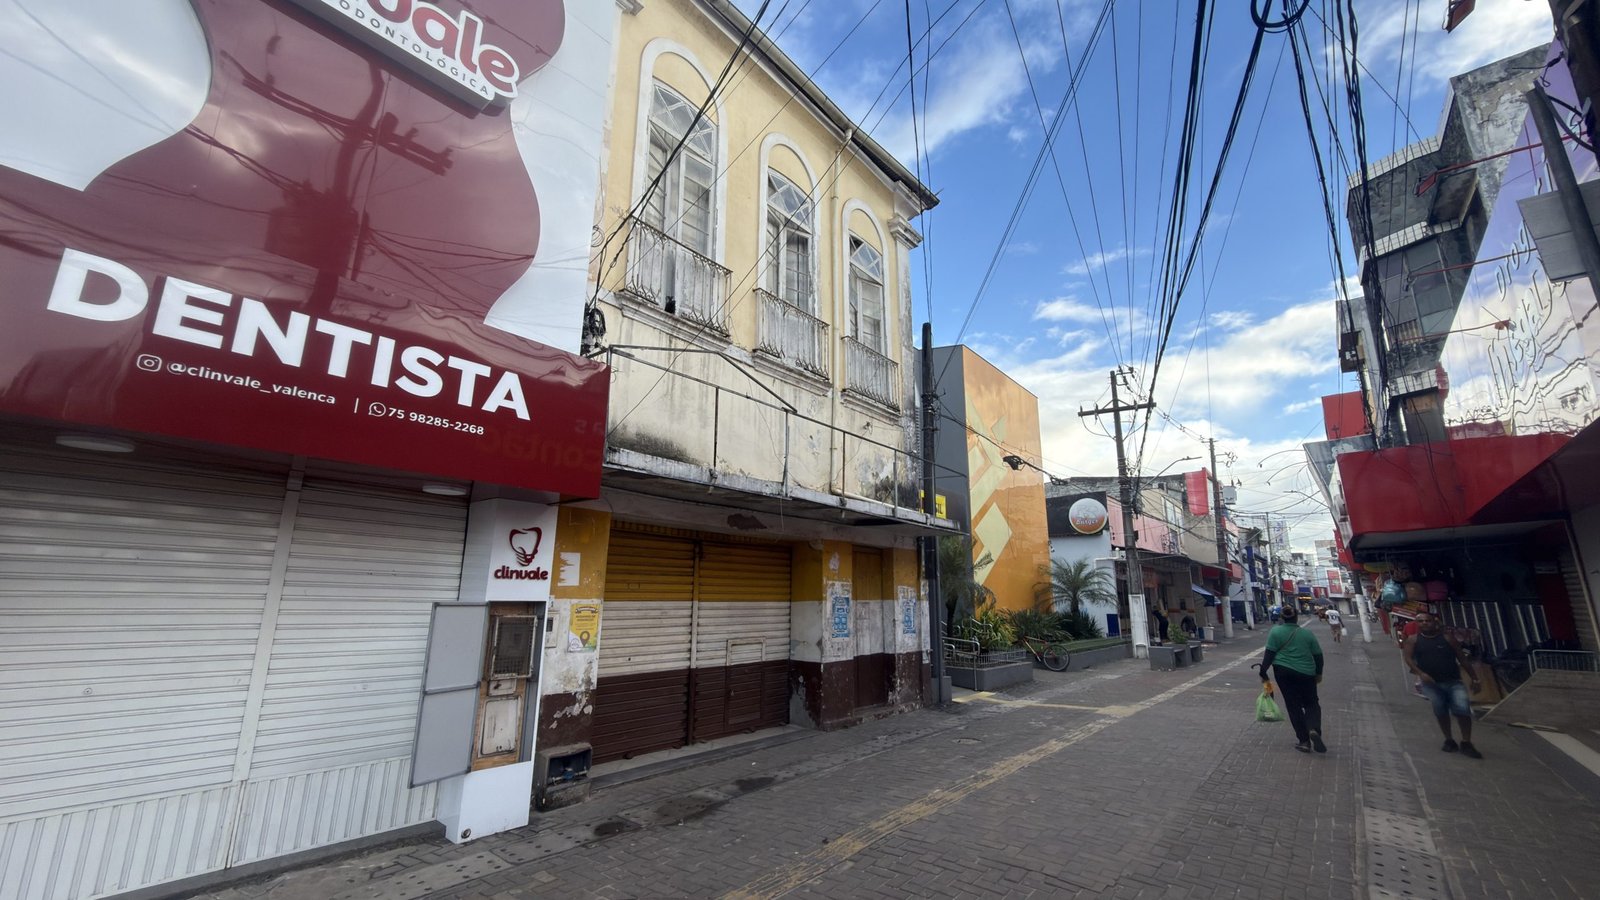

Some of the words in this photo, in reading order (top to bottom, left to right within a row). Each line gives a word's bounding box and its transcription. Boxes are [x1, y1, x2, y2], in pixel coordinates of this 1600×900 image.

[339, 0, 489, 95] ODONTOLÓGICA
[46, 248, 532, 421] DENTISTA
[166, 361, 337, 405] @clinvale_valenca
[388, 407, 406, 420] 75
[408, 412, 486, 436] 98285-2268
